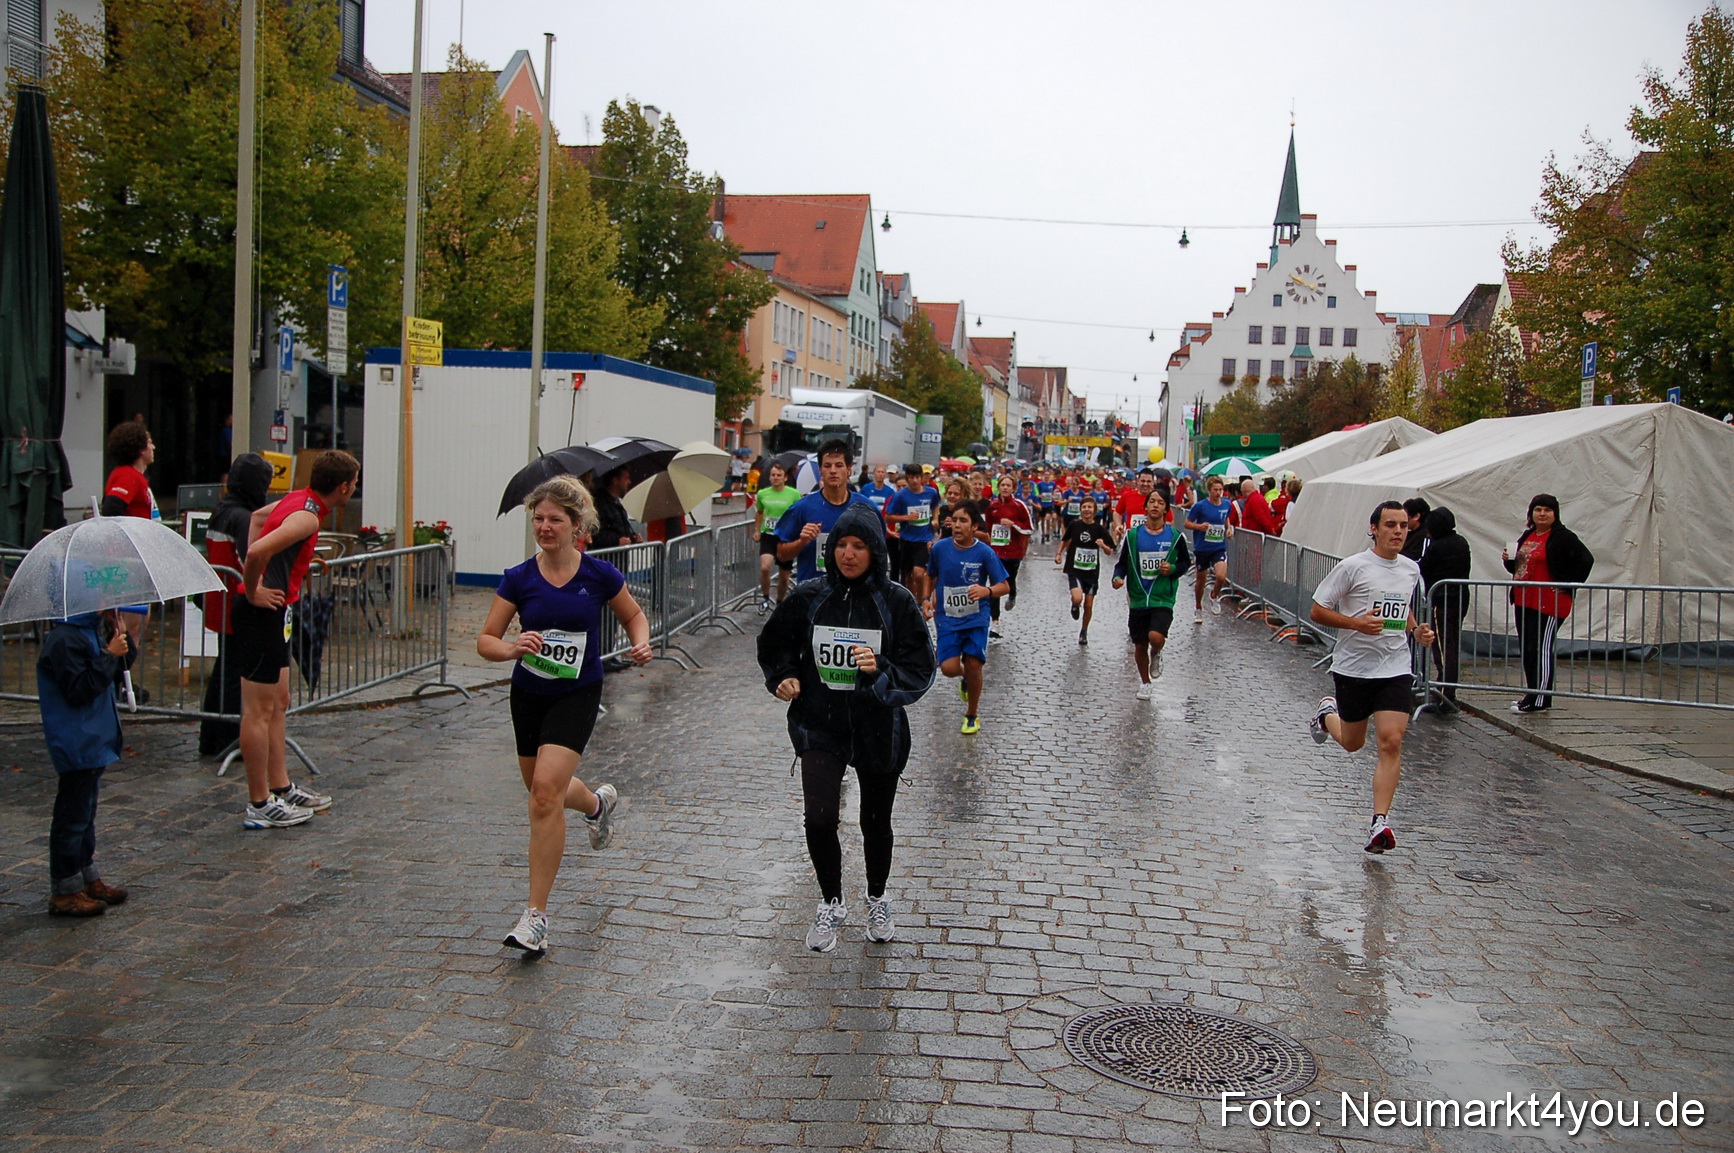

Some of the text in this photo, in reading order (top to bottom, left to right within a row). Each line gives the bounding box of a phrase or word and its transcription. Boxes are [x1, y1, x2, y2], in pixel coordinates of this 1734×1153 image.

[413, 320, 432, 331] Kinder-
[282, 332, 292, 366] P
[1585, 348, 1593, 374] P
[766, 519, 775, 528] 51
[1077, 553, 1096, 563] 5120
[1142, 558, 1166, 570] 508
[1373, 601, 1407, 619] 5067
[540, 643, 579, 665] 009
[819, 643, 874, 668] 506
[535, 658, 560, 675] Karina
[829, 671, 856, 681] Kathri
